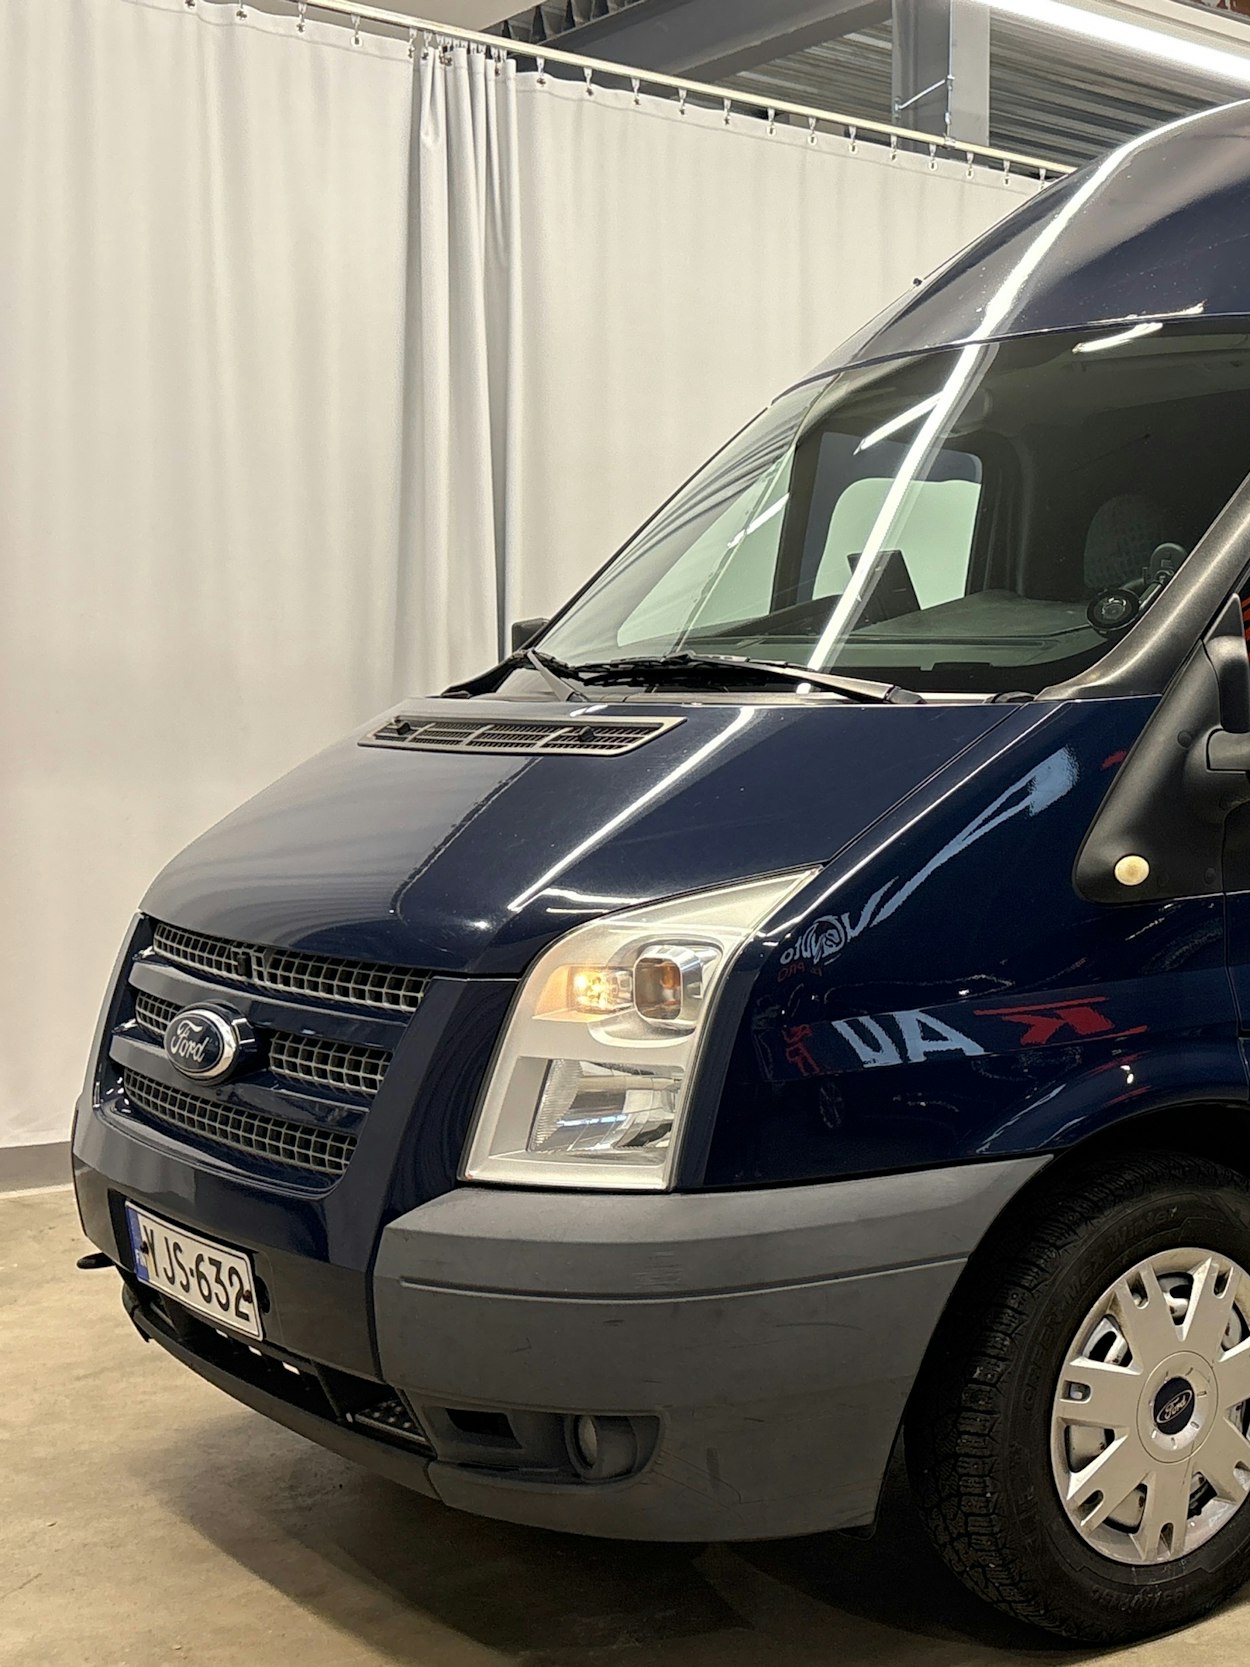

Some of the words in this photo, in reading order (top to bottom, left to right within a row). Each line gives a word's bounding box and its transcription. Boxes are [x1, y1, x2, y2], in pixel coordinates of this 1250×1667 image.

[170, 1019, 210, 1063] Ford
[143, 1225, 250, 1322] YJS-632
[1164, 1394, 1187, 1420] Ford
